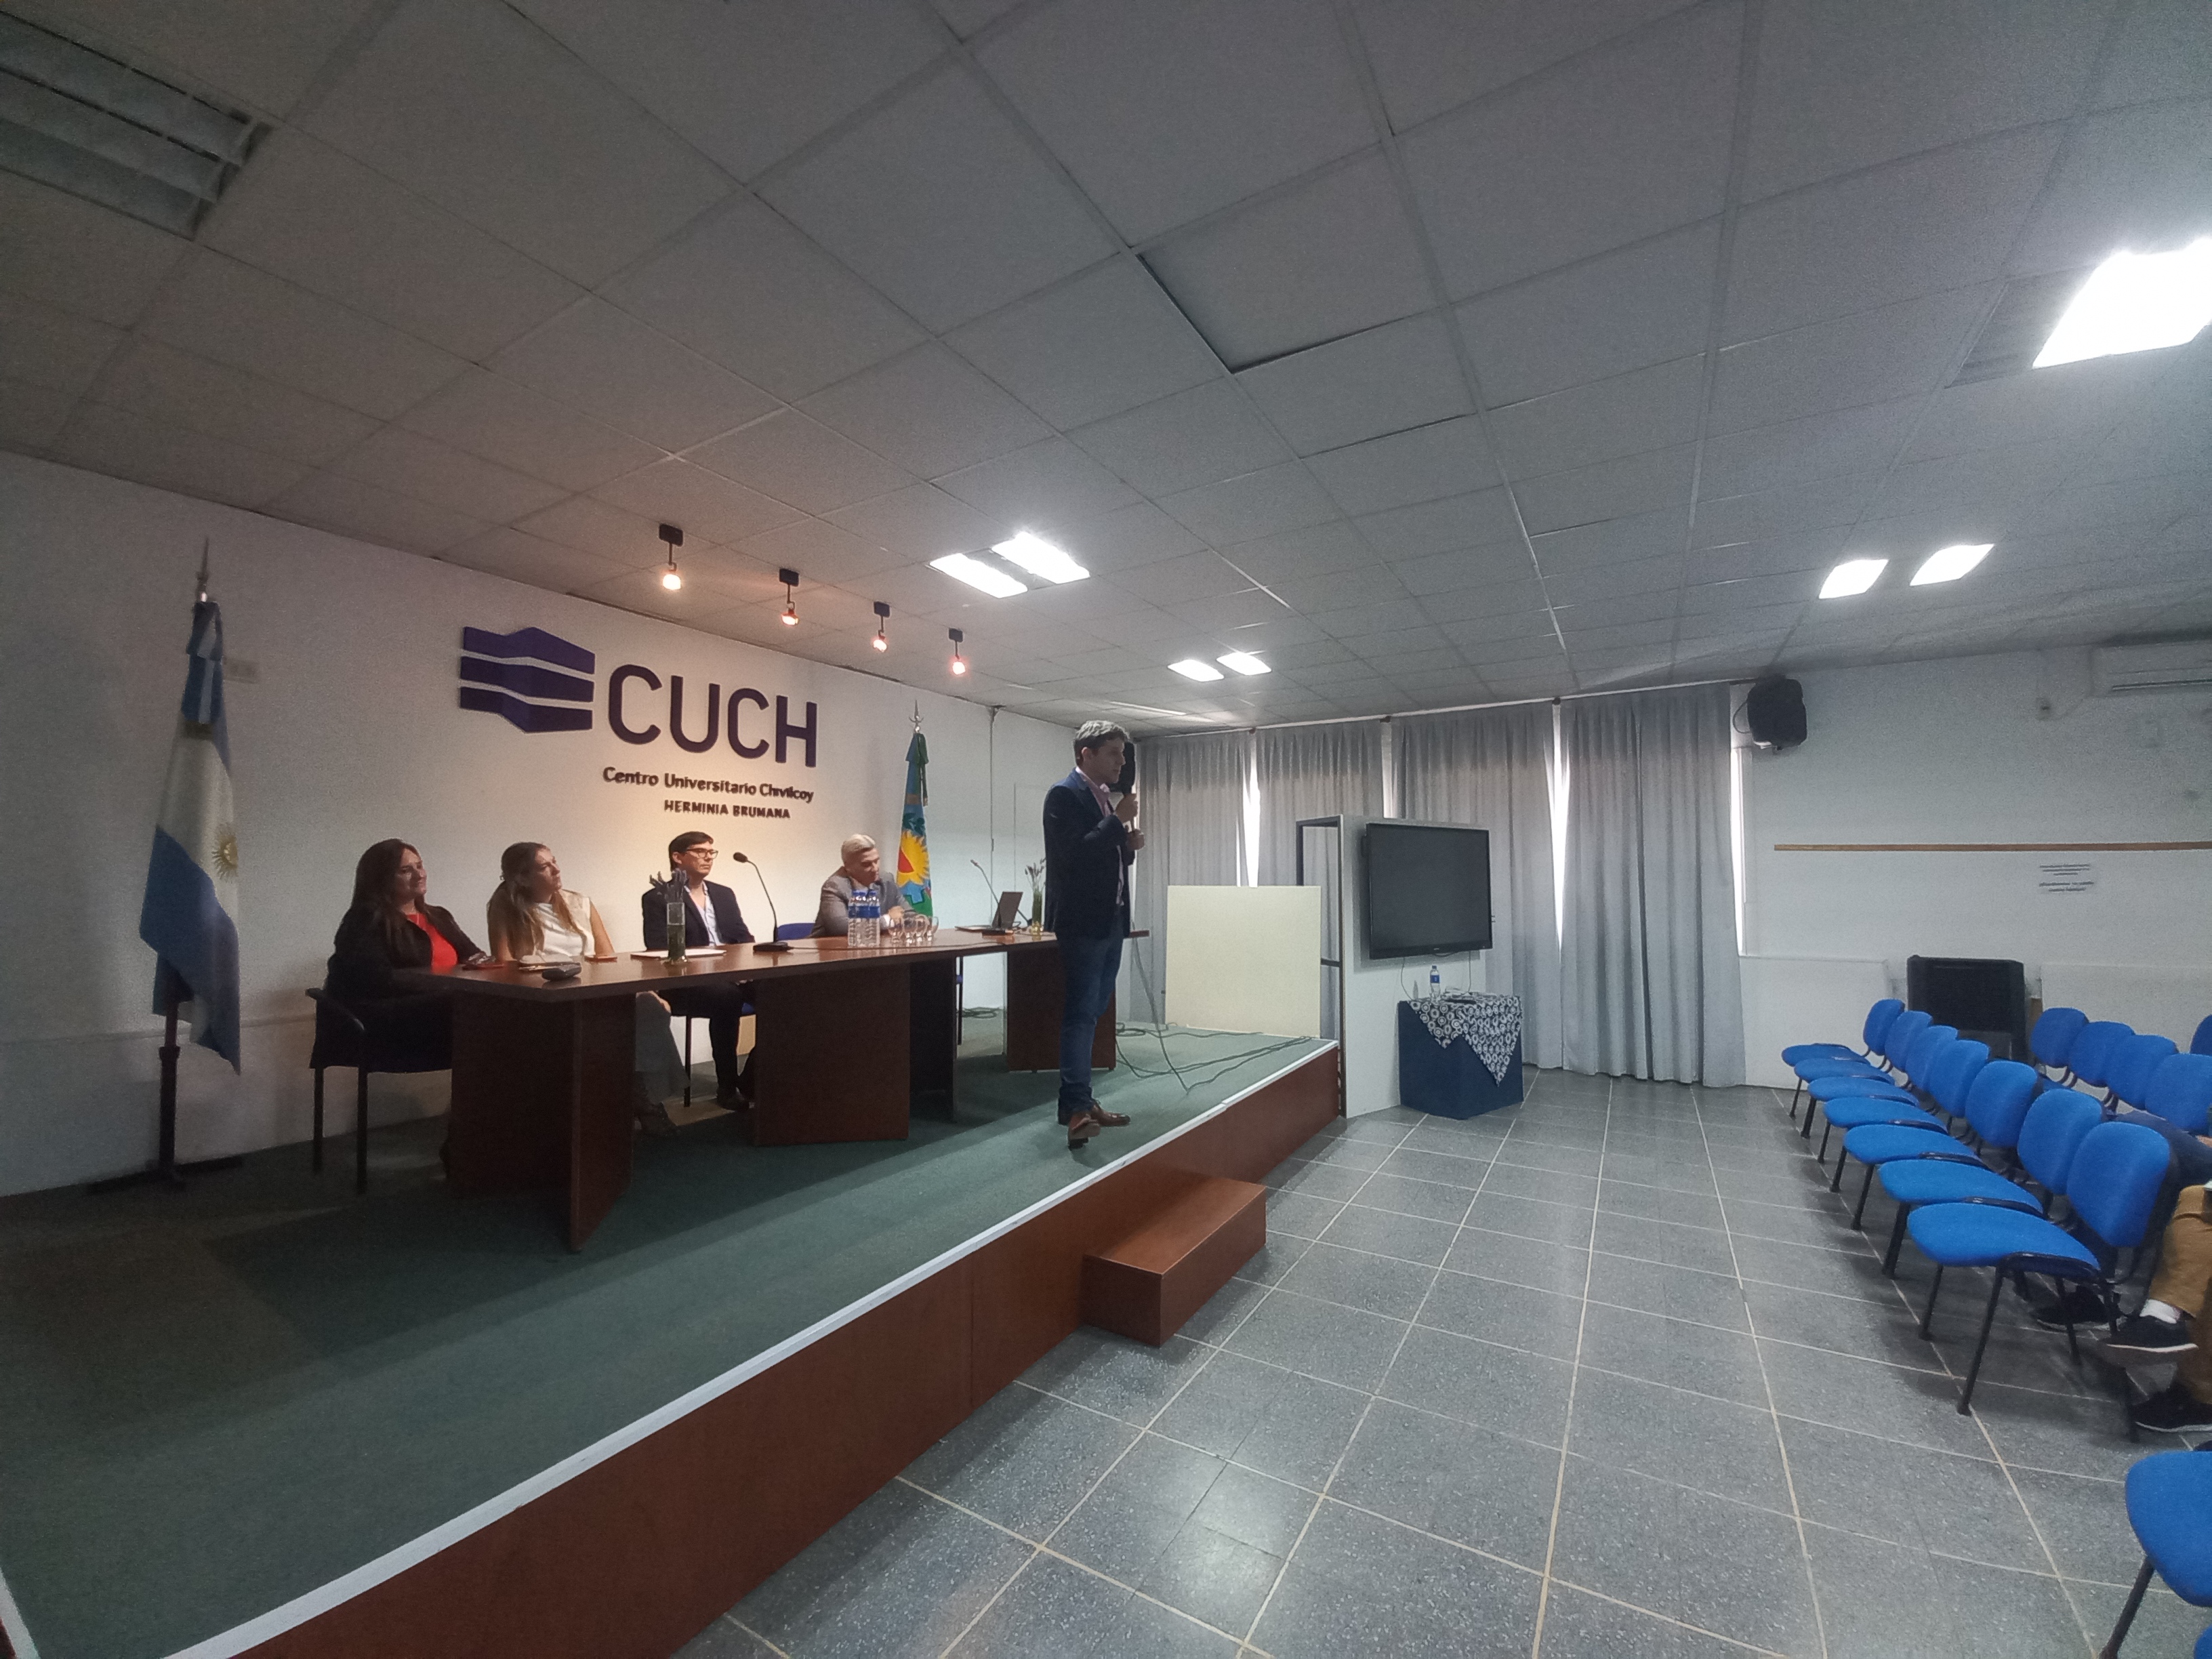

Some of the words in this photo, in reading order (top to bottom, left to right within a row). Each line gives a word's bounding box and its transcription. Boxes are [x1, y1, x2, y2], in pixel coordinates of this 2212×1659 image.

[609, 664, 817, 768] CUCH
[602, 766, 659, 786] Centro
[664, 773, 756, 796] Universitario
[663, 800, 729, 815] HERMINIA
[733, 804, 791, 819] BRUMANA
